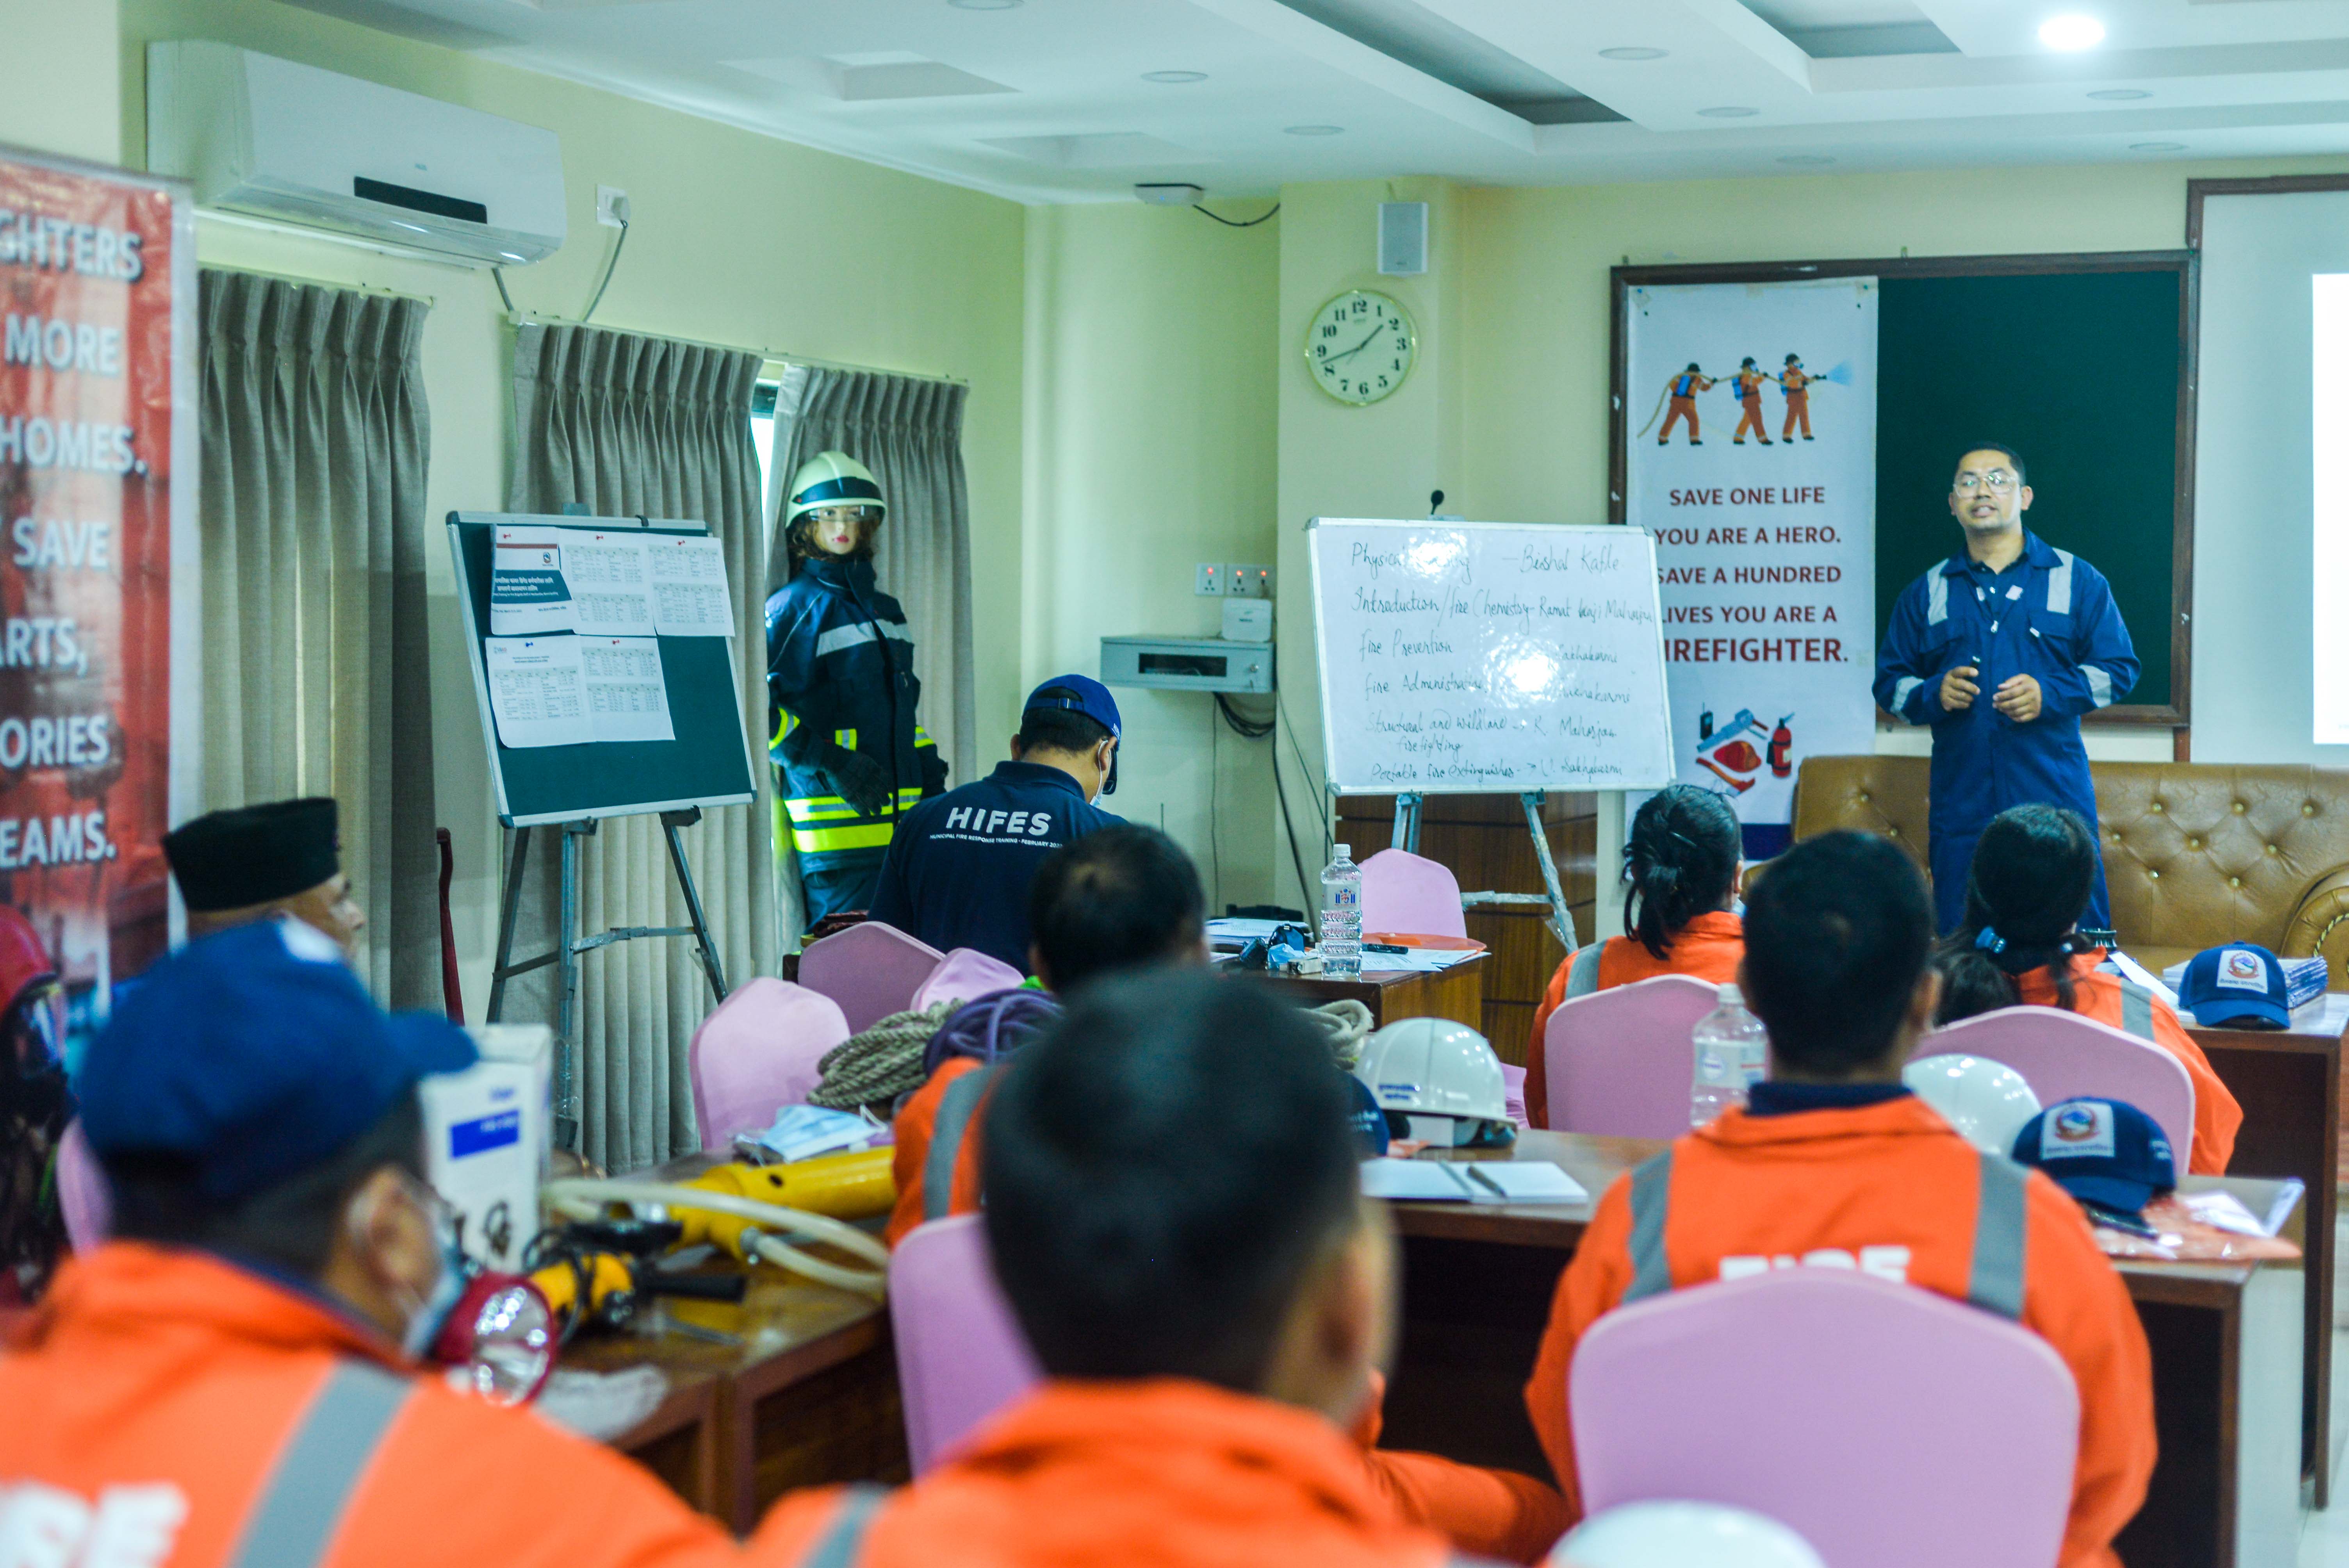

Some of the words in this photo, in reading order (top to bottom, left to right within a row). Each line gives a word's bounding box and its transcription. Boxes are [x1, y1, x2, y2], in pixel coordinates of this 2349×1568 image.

[1335, 308, 1346, 321] 11
[1353, 300, 1367, 313] 12
[1377, 305, 1382, 317] 1
[1322, 324, 1337, 338] 10
[1389, 318, 1399, 331] 2
[5, 313, 121, 374] MORE
[1317, 344, 1327, 357] 9
[1397, 337, 1407, 351] 3
[1359, 382, 1369, 395] 6
[1378, 375, 1388, 388] 5
[0, 415, 147, 477] HOMES.
[1670, 489, 1723, 506] SAVE
[1731, 488, 1775, 504] ONE
[1782, 487, 1825, 504] LIFE
[13, 517, 109, 569] SAVE
[1654, 528, 1698, 544] YOU
[1706, 527, 1747, 544] ARE
[1754, 527, 1769, 543] A
[1776, 526, 1841, 543] HERO.
[1352, 542, 1404, 580] Physica
[1713, 567, 1727, 584] A
[1735, 566, 1841, 584] HUNDRED
[1662, 606, 1713, 623] IVES
[1721, 606, 1765, 623] YOU
[1773, 606, 1816, 622] ARE
[1823, 606, 1837, 622] A
[0, 618, 87, 677] RTS,
[1665, 638, 1848, 662] IREFIGHTER.
[1429, 709, 1451, 731] and
[0, 715, 110, 769] ORIES
[946, 807, 1052, 836] HIFES
[968, 835, 995, 843] RESPONSE
[1021, 839, 1049, 847] FEBRUARY
